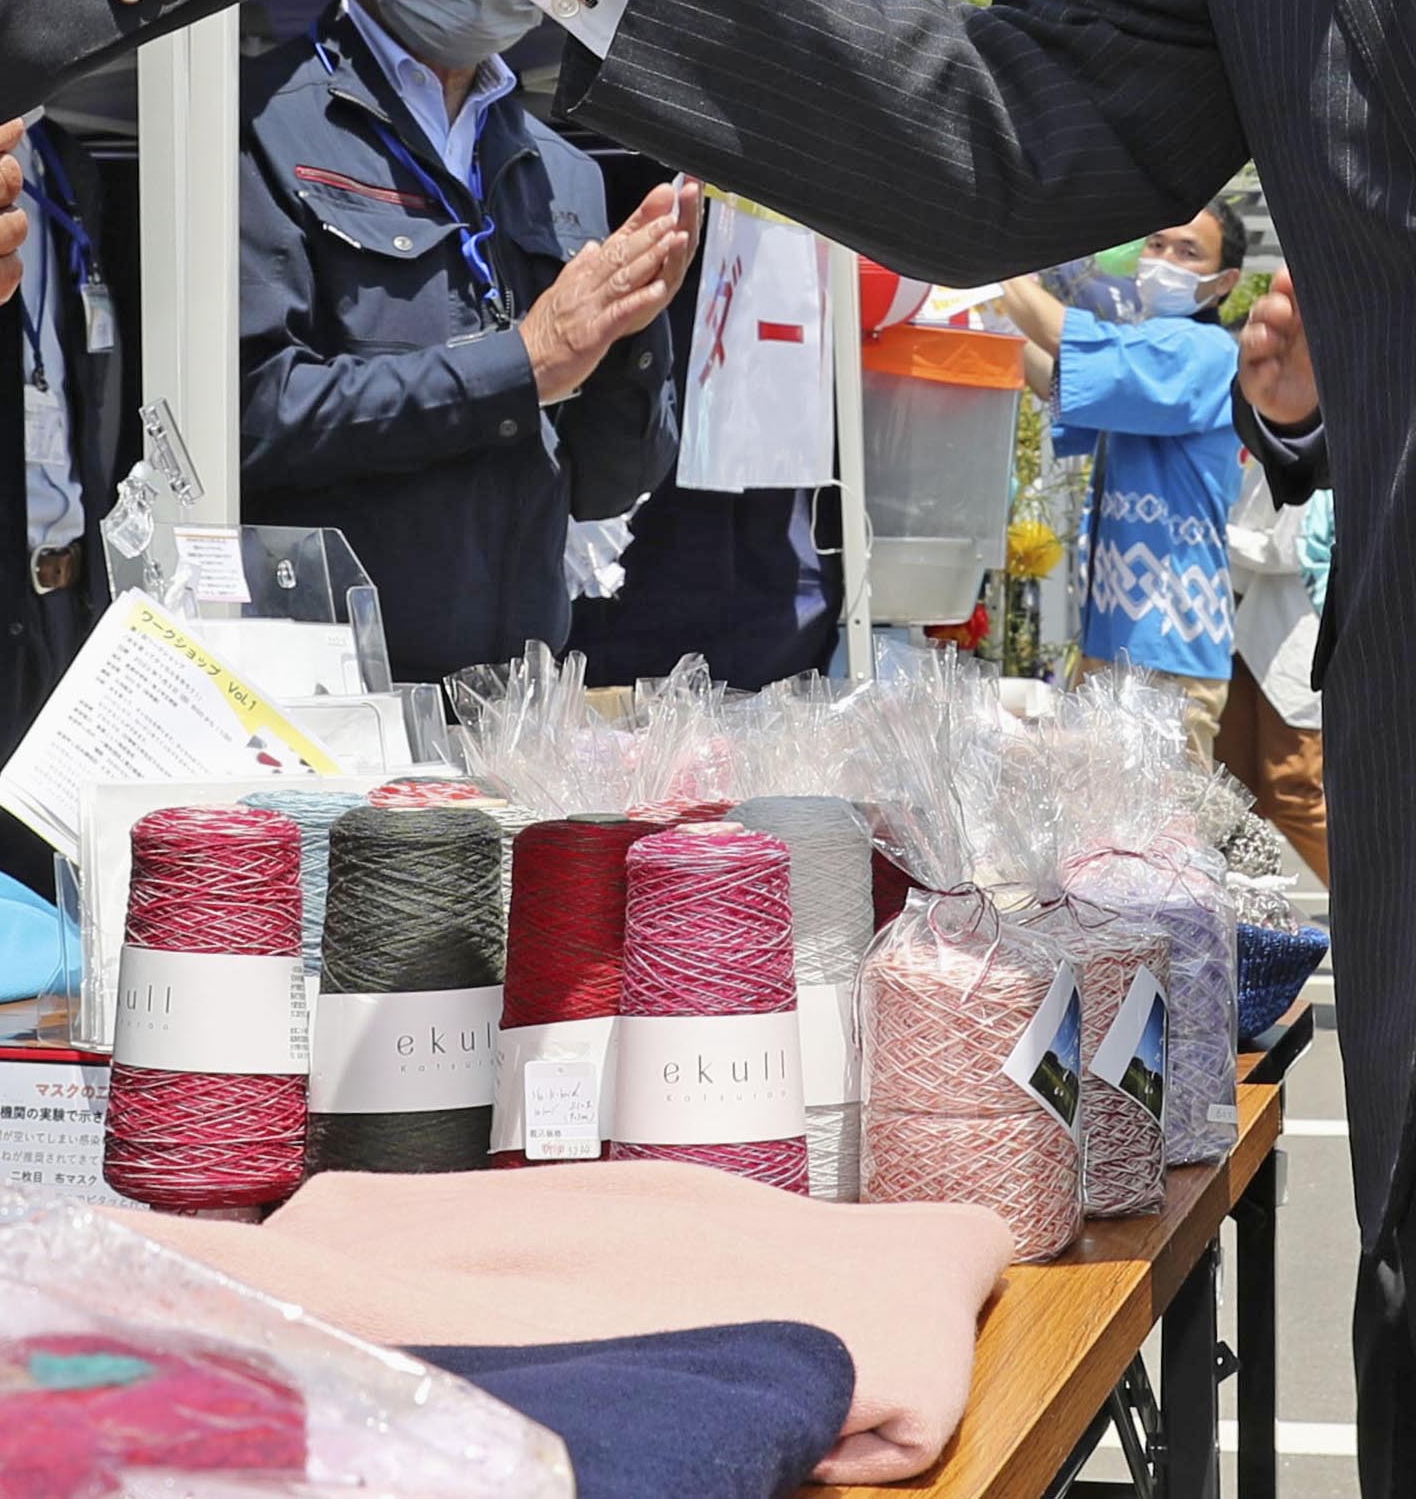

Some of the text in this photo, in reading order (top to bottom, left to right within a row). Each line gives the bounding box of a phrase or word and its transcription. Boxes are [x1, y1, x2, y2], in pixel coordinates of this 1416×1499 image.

[141, 610, 222, 676] ワークショップ
[119, 984, 171, 1014] ull
[663, 1049, 786, 1084] ekull
[10, 1170, 43, 1183] 二枚目
